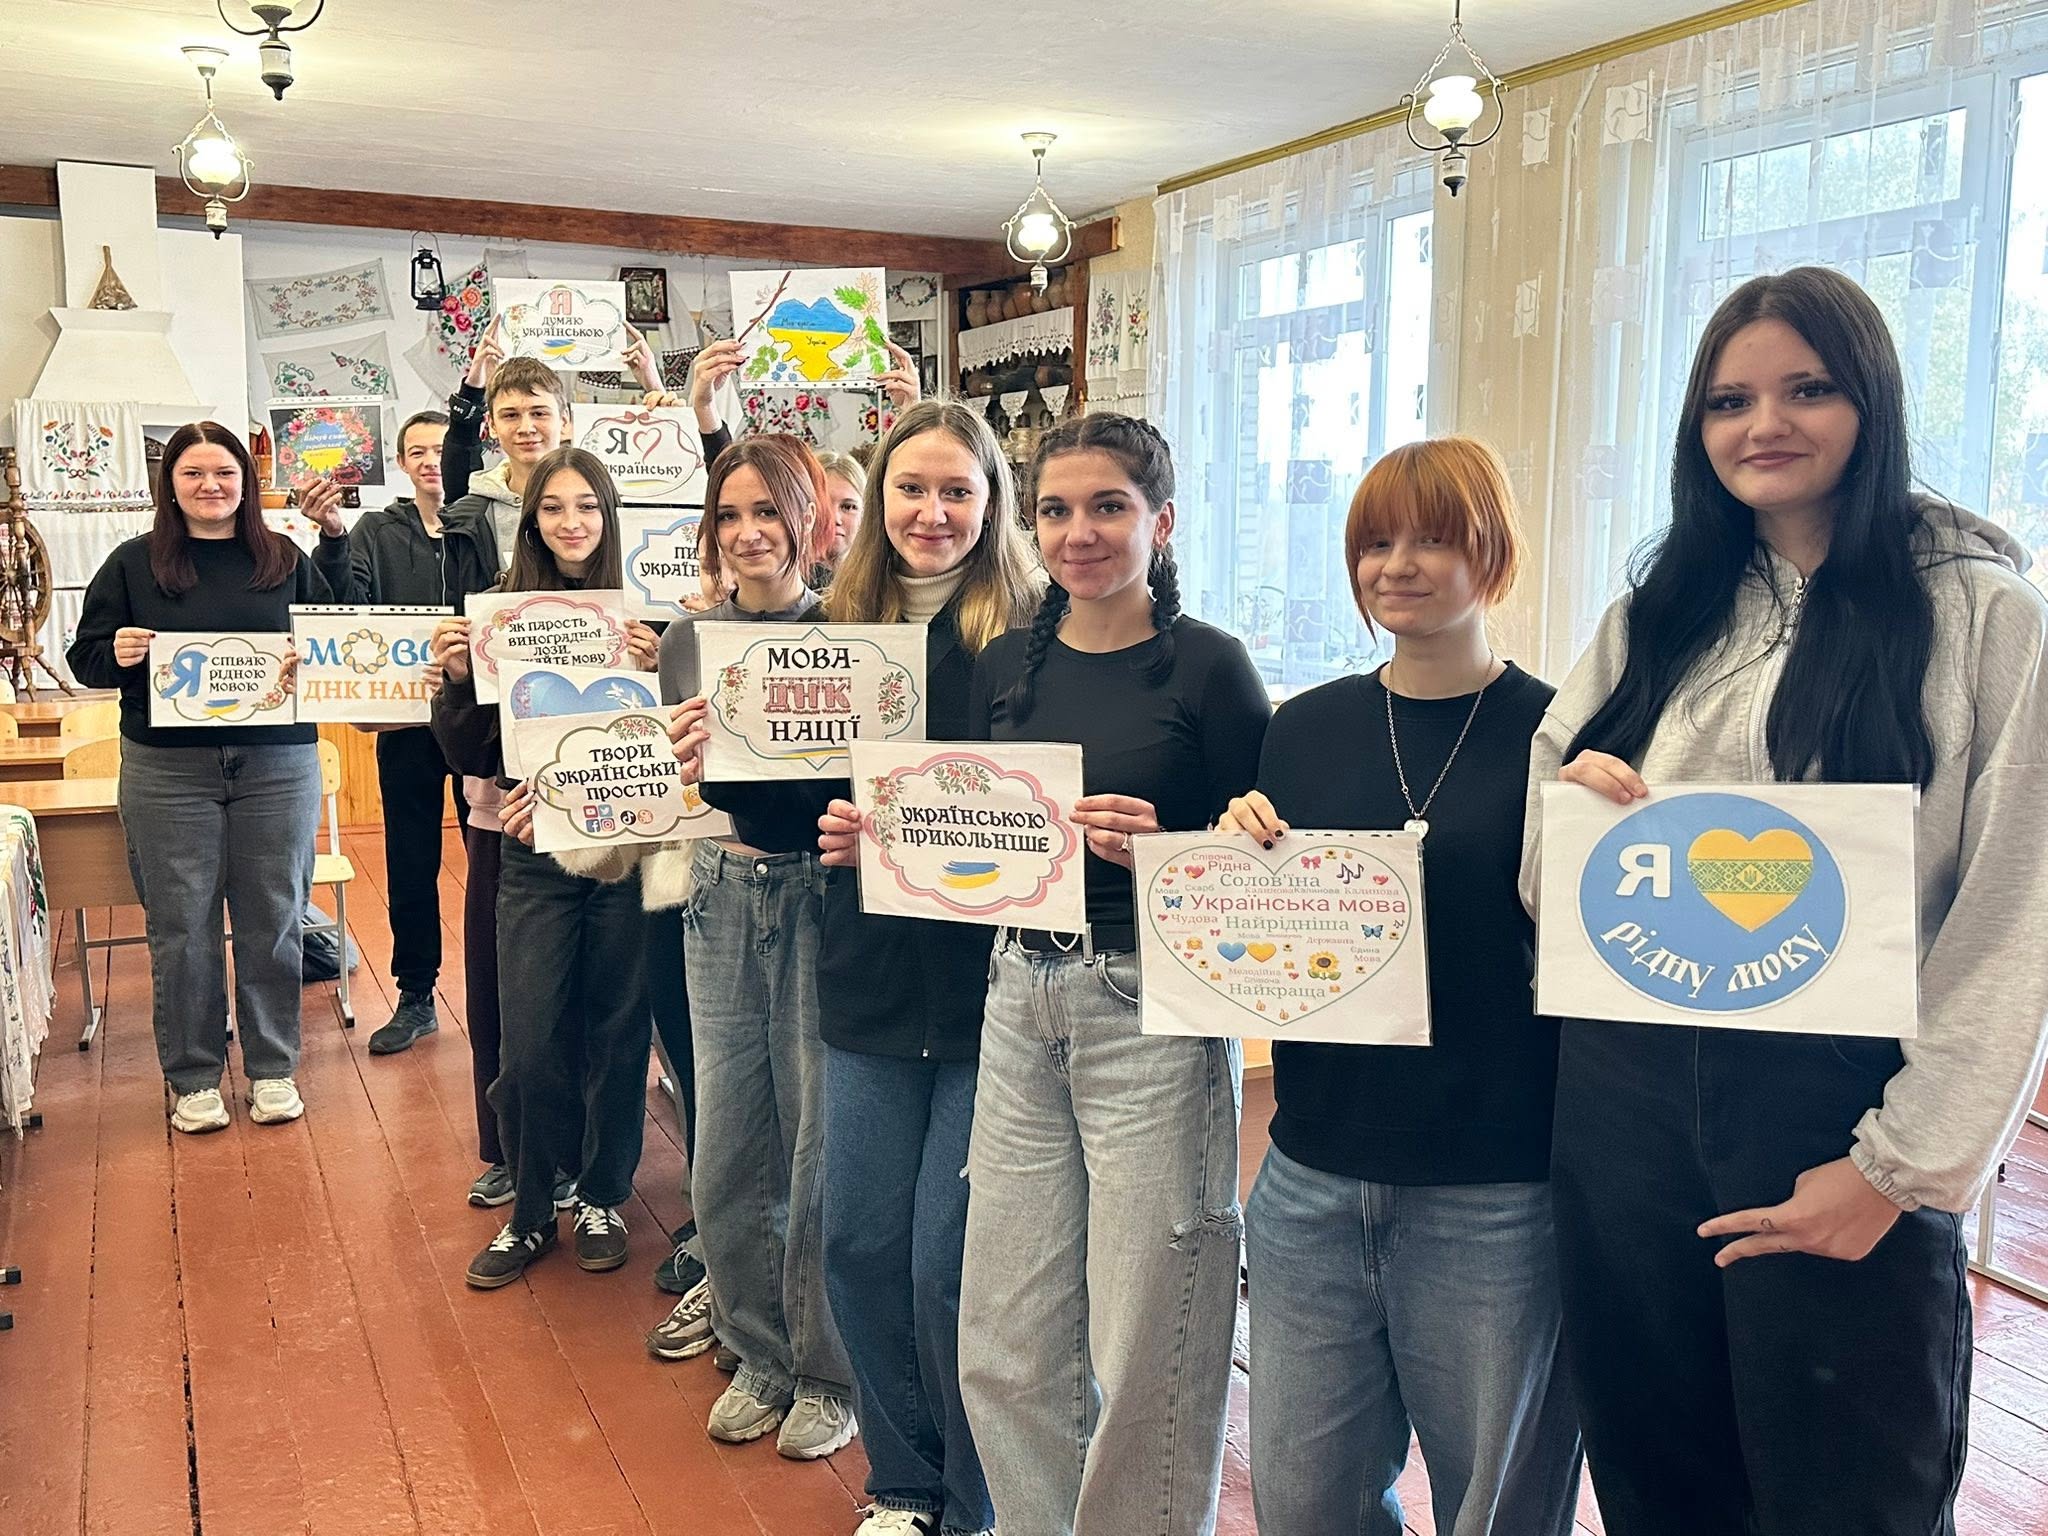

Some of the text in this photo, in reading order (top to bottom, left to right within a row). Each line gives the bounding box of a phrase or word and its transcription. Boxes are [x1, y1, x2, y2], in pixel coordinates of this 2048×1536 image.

[549, 290, 572, 315] Я
[542, 317, 583, 326] ДУМАЮ
[522, 327, 604, 337] УКРАЇНСЬКОЮ
[605, 428, 629, 455] Я
[609, 461, 682, 478] країнську
[675, 546, 698, 559] ПИ
[640, 562, 700, 578] УКРАЇН
[509, 617, 587, 633] ЯК ПАРОСТЬ
[212, 656, 266, 666] СПІВАЮ
[572, 653, 606, 666] МОВУ
[768, 648, 860, 673] МОВА-
[160, 650, 208, 699] Я
[209, 669, 266, 680] РІДНОЮ
[209, 682, 258, 693] МОВОЮ
[304, 680, 428, 704] ДНК НАЦ
[763, 679, 851, 712] ДНК
[767, 715, 861, 744] НАЦІЇ
[588, 744, 655, 763] ТВОРИ
[554, 760, 682, 787] УКРАЇНСЬКИ
[586, 782, 668, 801] ПРОСТІР
[900, 806, 1046, 830] УКРАЇНСЬКОЮ
[902, 828, 1049, 853] ПРИКОЛЬНІШЕ
[1191, 852, 1233, 861] Співоча
[1208, 860, 1251, 872] Рідна
[1615, 843, 1671, 898] Я
[1185, 883, 1215, 892] Скарб
[1220, 873, 1320, 888] Солов'їна
[1155, 887, 1179, 895] Мова
[1190, 895, 1406, 913] Українська мова
[1171, 914, 1218, 925] Чудова
[1226, 916, 1350, 932] Найрідніша
[1354, 955, 1382, 963] Мова
[1727, 924, 1830, 993] мову
[1228, 967, 1282, 977] Мелодійна
[1230, 983, 1326, 999] Найкраща
